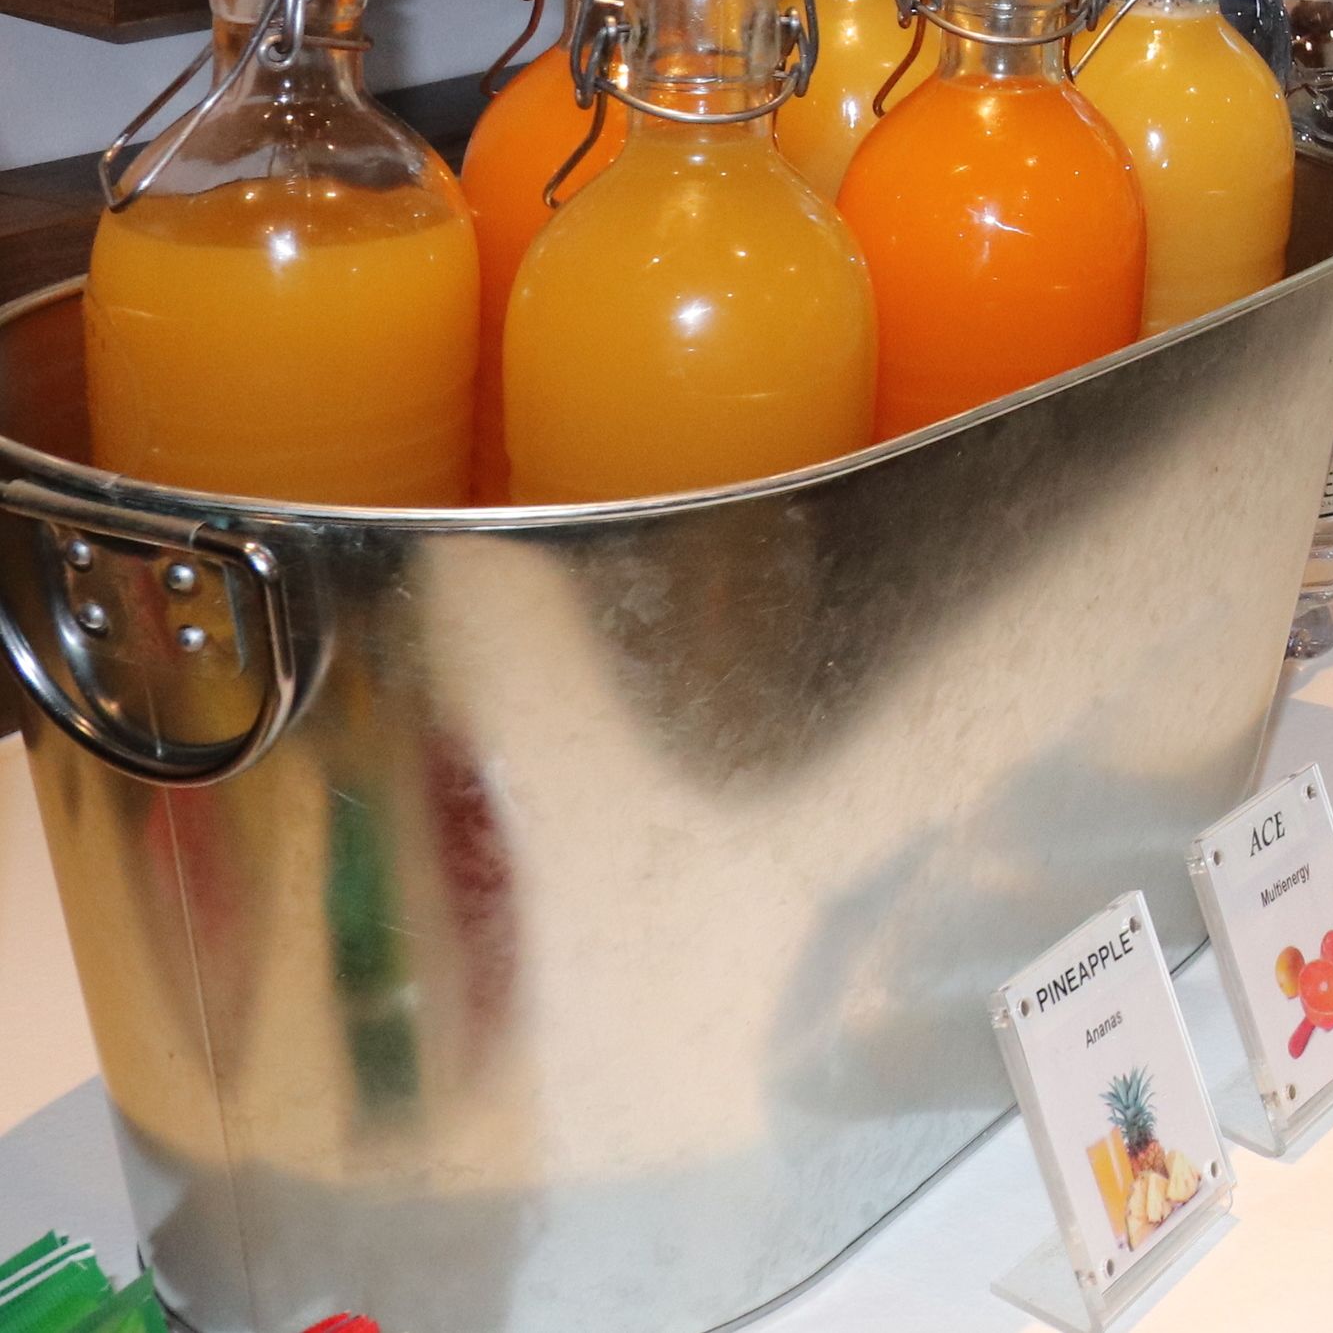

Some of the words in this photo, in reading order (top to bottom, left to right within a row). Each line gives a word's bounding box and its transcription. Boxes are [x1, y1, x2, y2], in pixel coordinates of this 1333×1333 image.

[1249, 811, 1286, 858] ACE
[1260, 863, 1311, 907] Multienergy
[1036, 930, 1134, 1013] PINEAPPLE
[1086, 1010, 1124, 1048] Ananas
